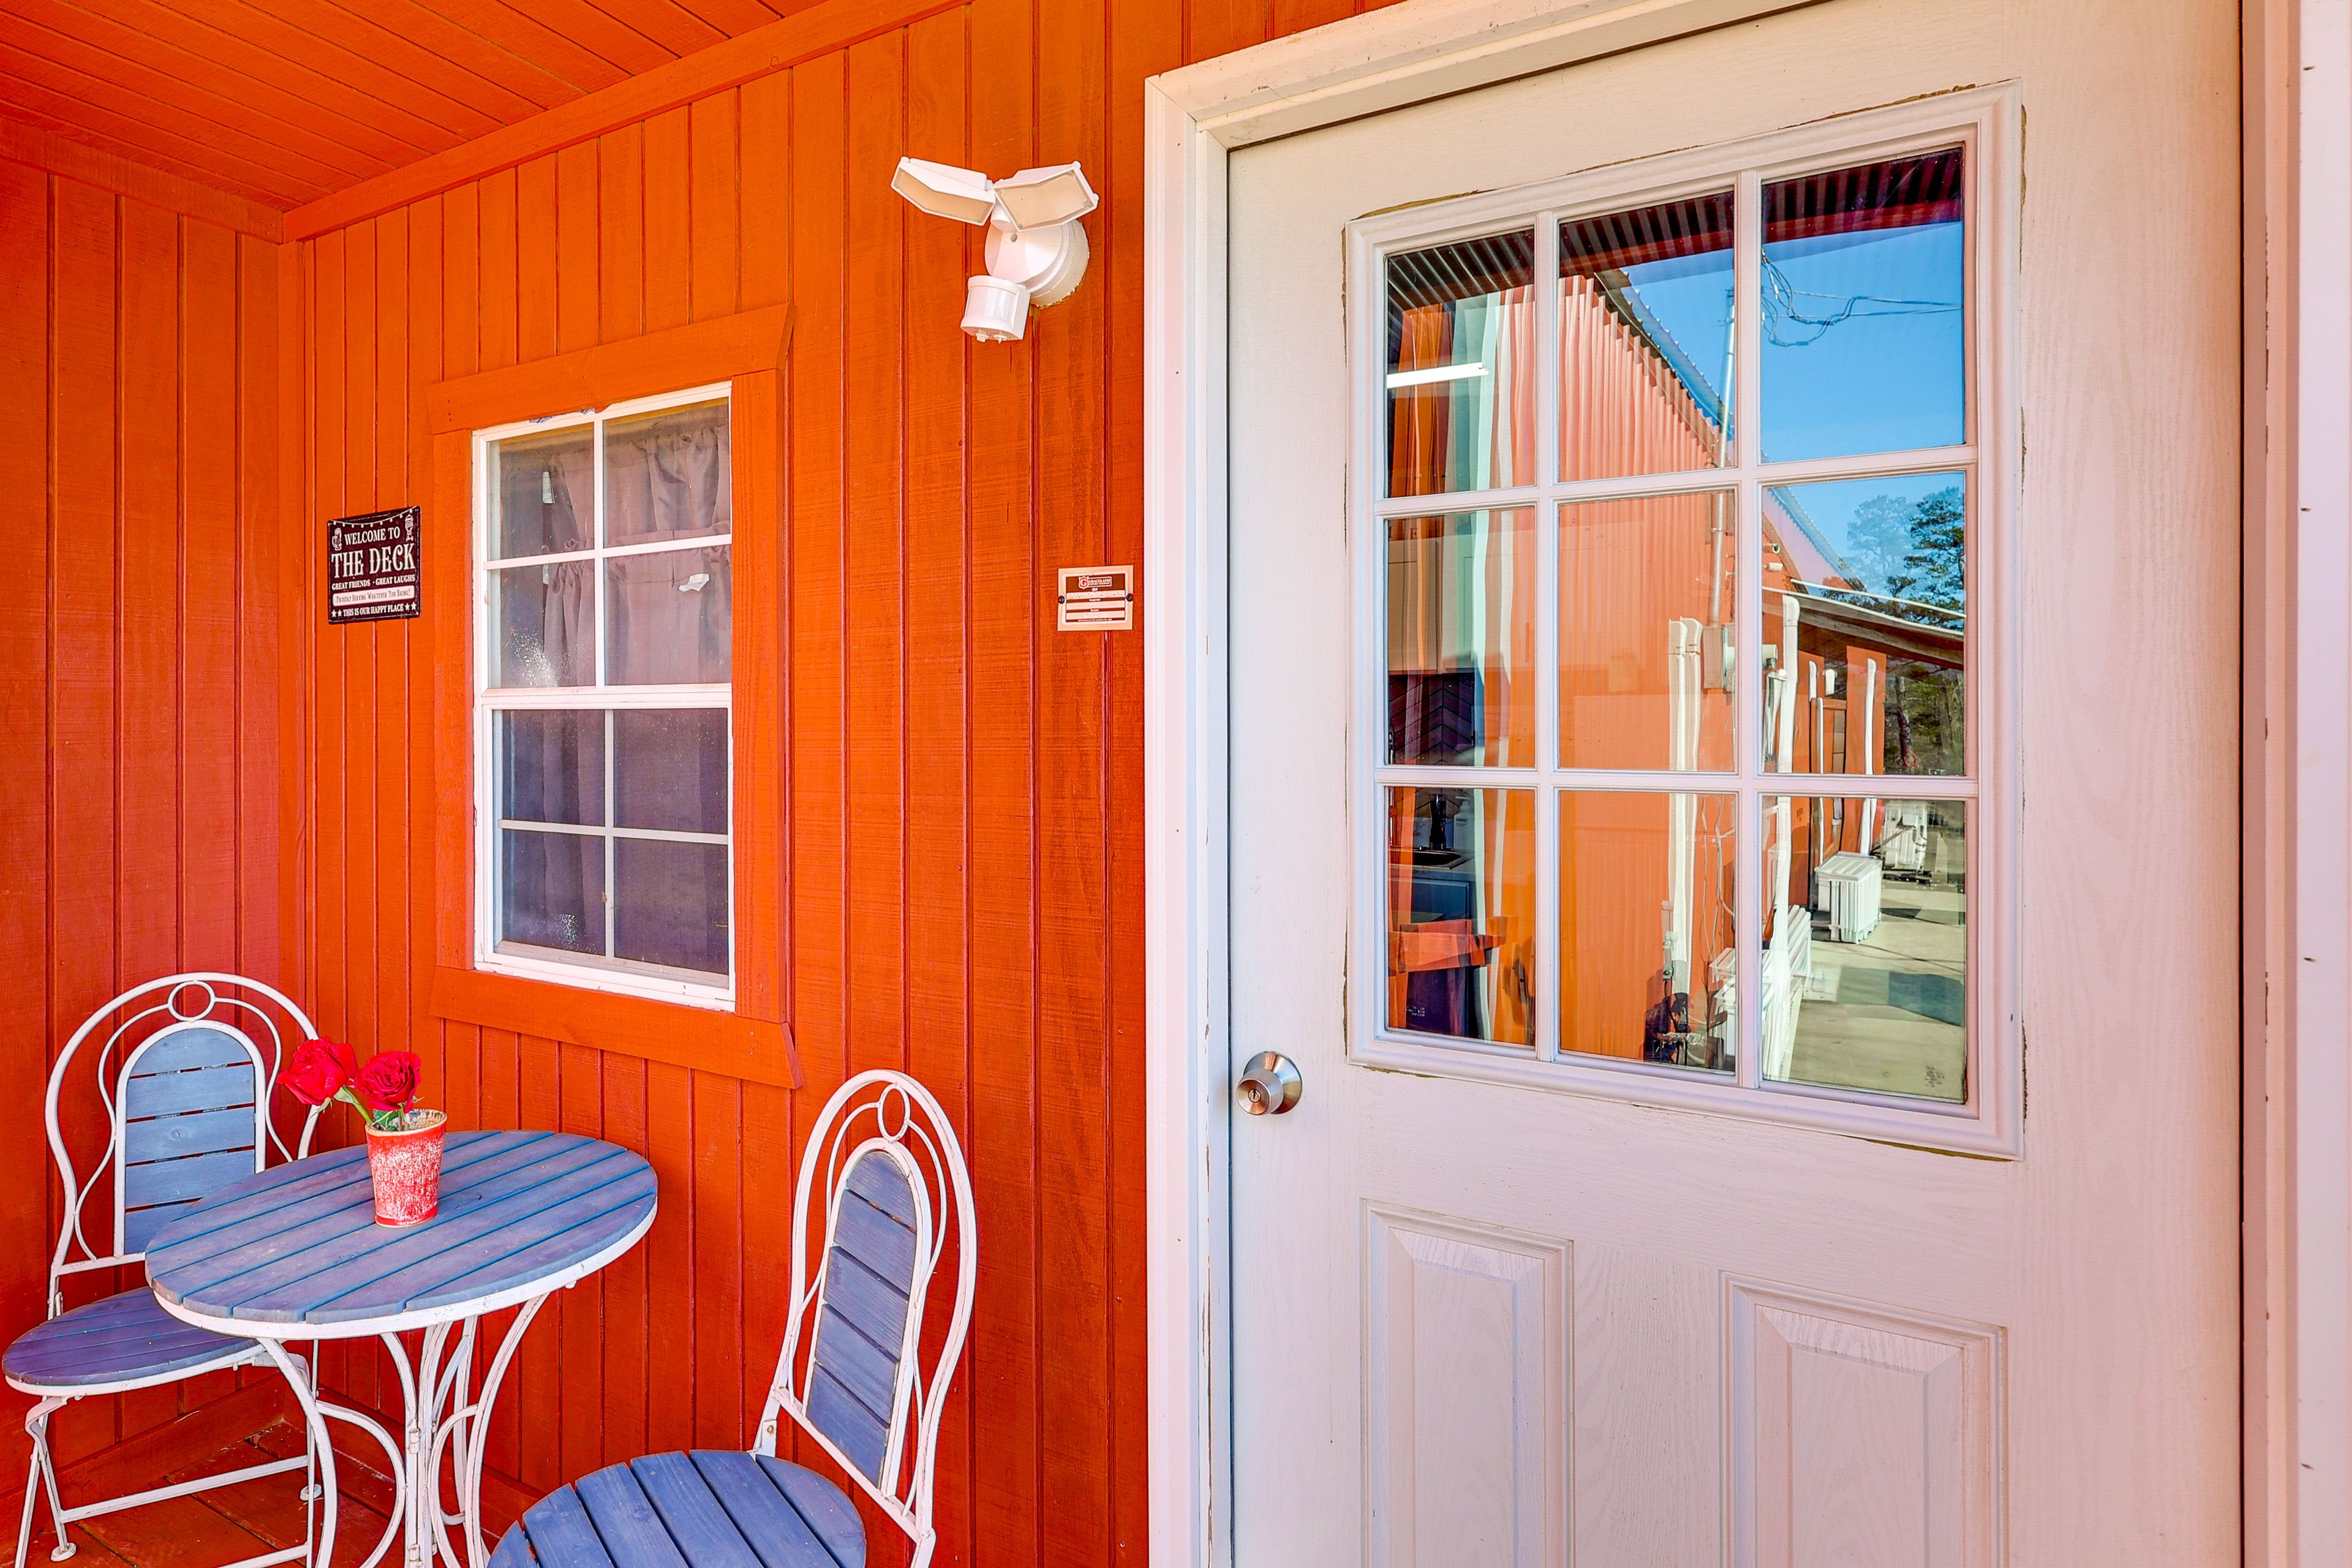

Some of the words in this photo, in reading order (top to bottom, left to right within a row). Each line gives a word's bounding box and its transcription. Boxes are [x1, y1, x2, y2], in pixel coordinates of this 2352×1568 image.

[344, 528, 386, 545] WELCOME
[388, 527, 401, 539] TO
[331, 550, 364, 578] THE
[369, 543, 415, 574] DECK
[331, 582, 348, 590] GREAT
[349, 579, 371, 588] FRIENDS
[394, 574, 415, 584] LAUGHS
[343, 608, 354, 617] THIS
[371, 605, 387, 614] HAPPY
[387, 603, 404, 612] PLACE
